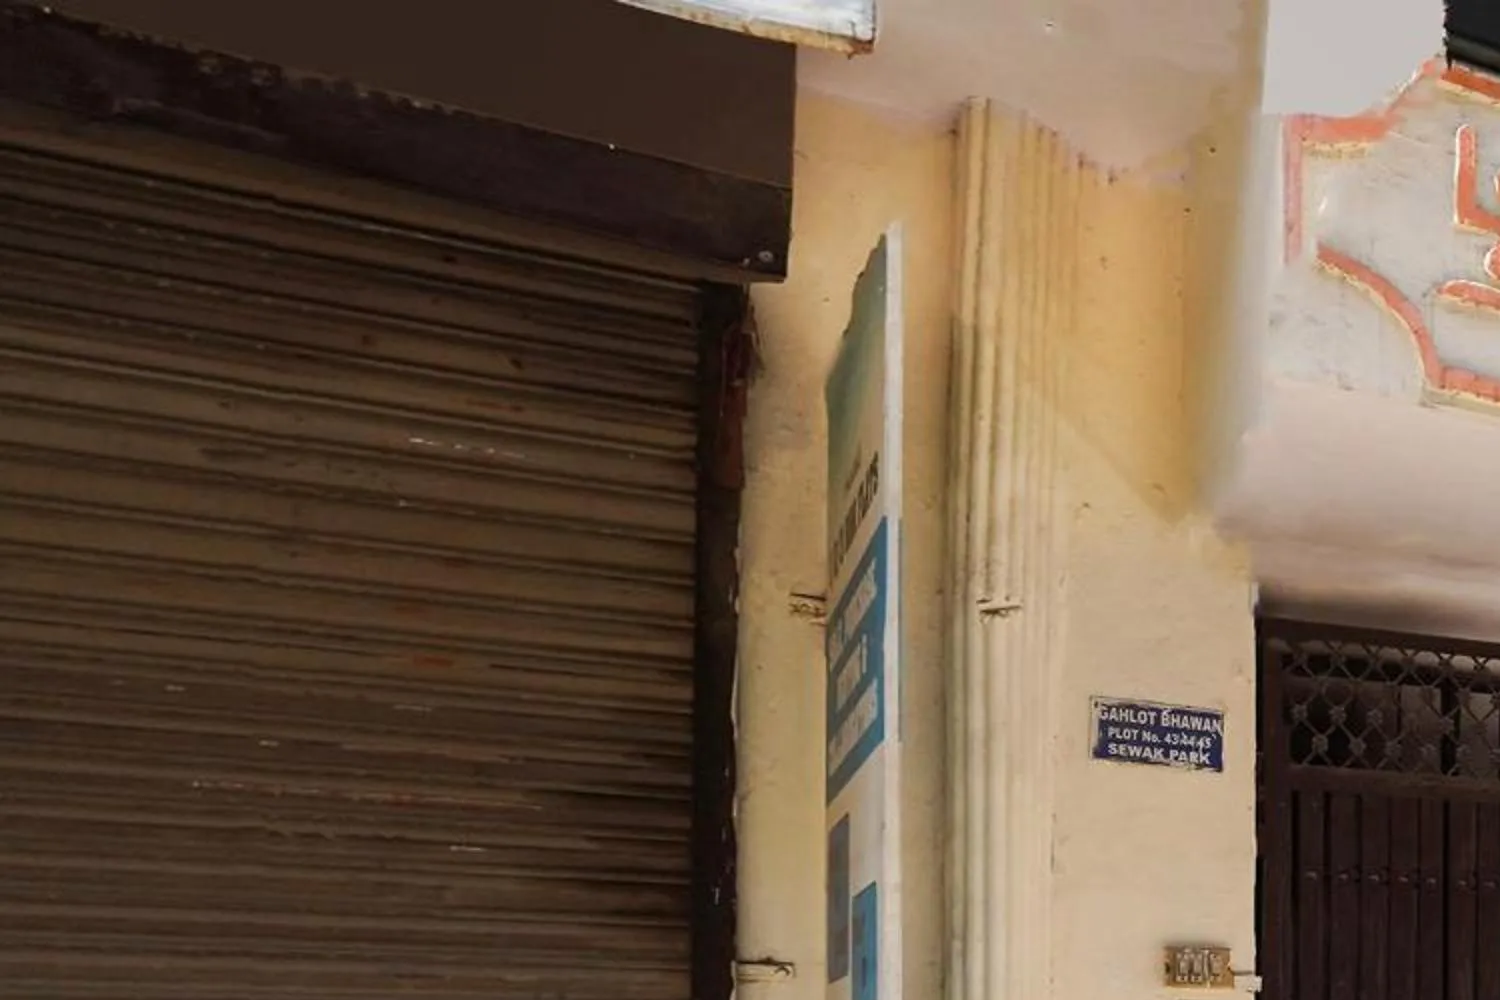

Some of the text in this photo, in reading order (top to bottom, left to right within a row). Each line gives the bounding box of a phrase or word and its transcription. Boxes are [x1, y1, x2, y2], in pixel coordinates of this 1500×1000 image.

[1100, 704, 1222, 736] GAHLOT BHAWAN
[1107, 726, 1139, 741] PLOT
[1142, 731, 1160, 743] No.
[1107, 743, 1211, 765] SEWAK PARK
